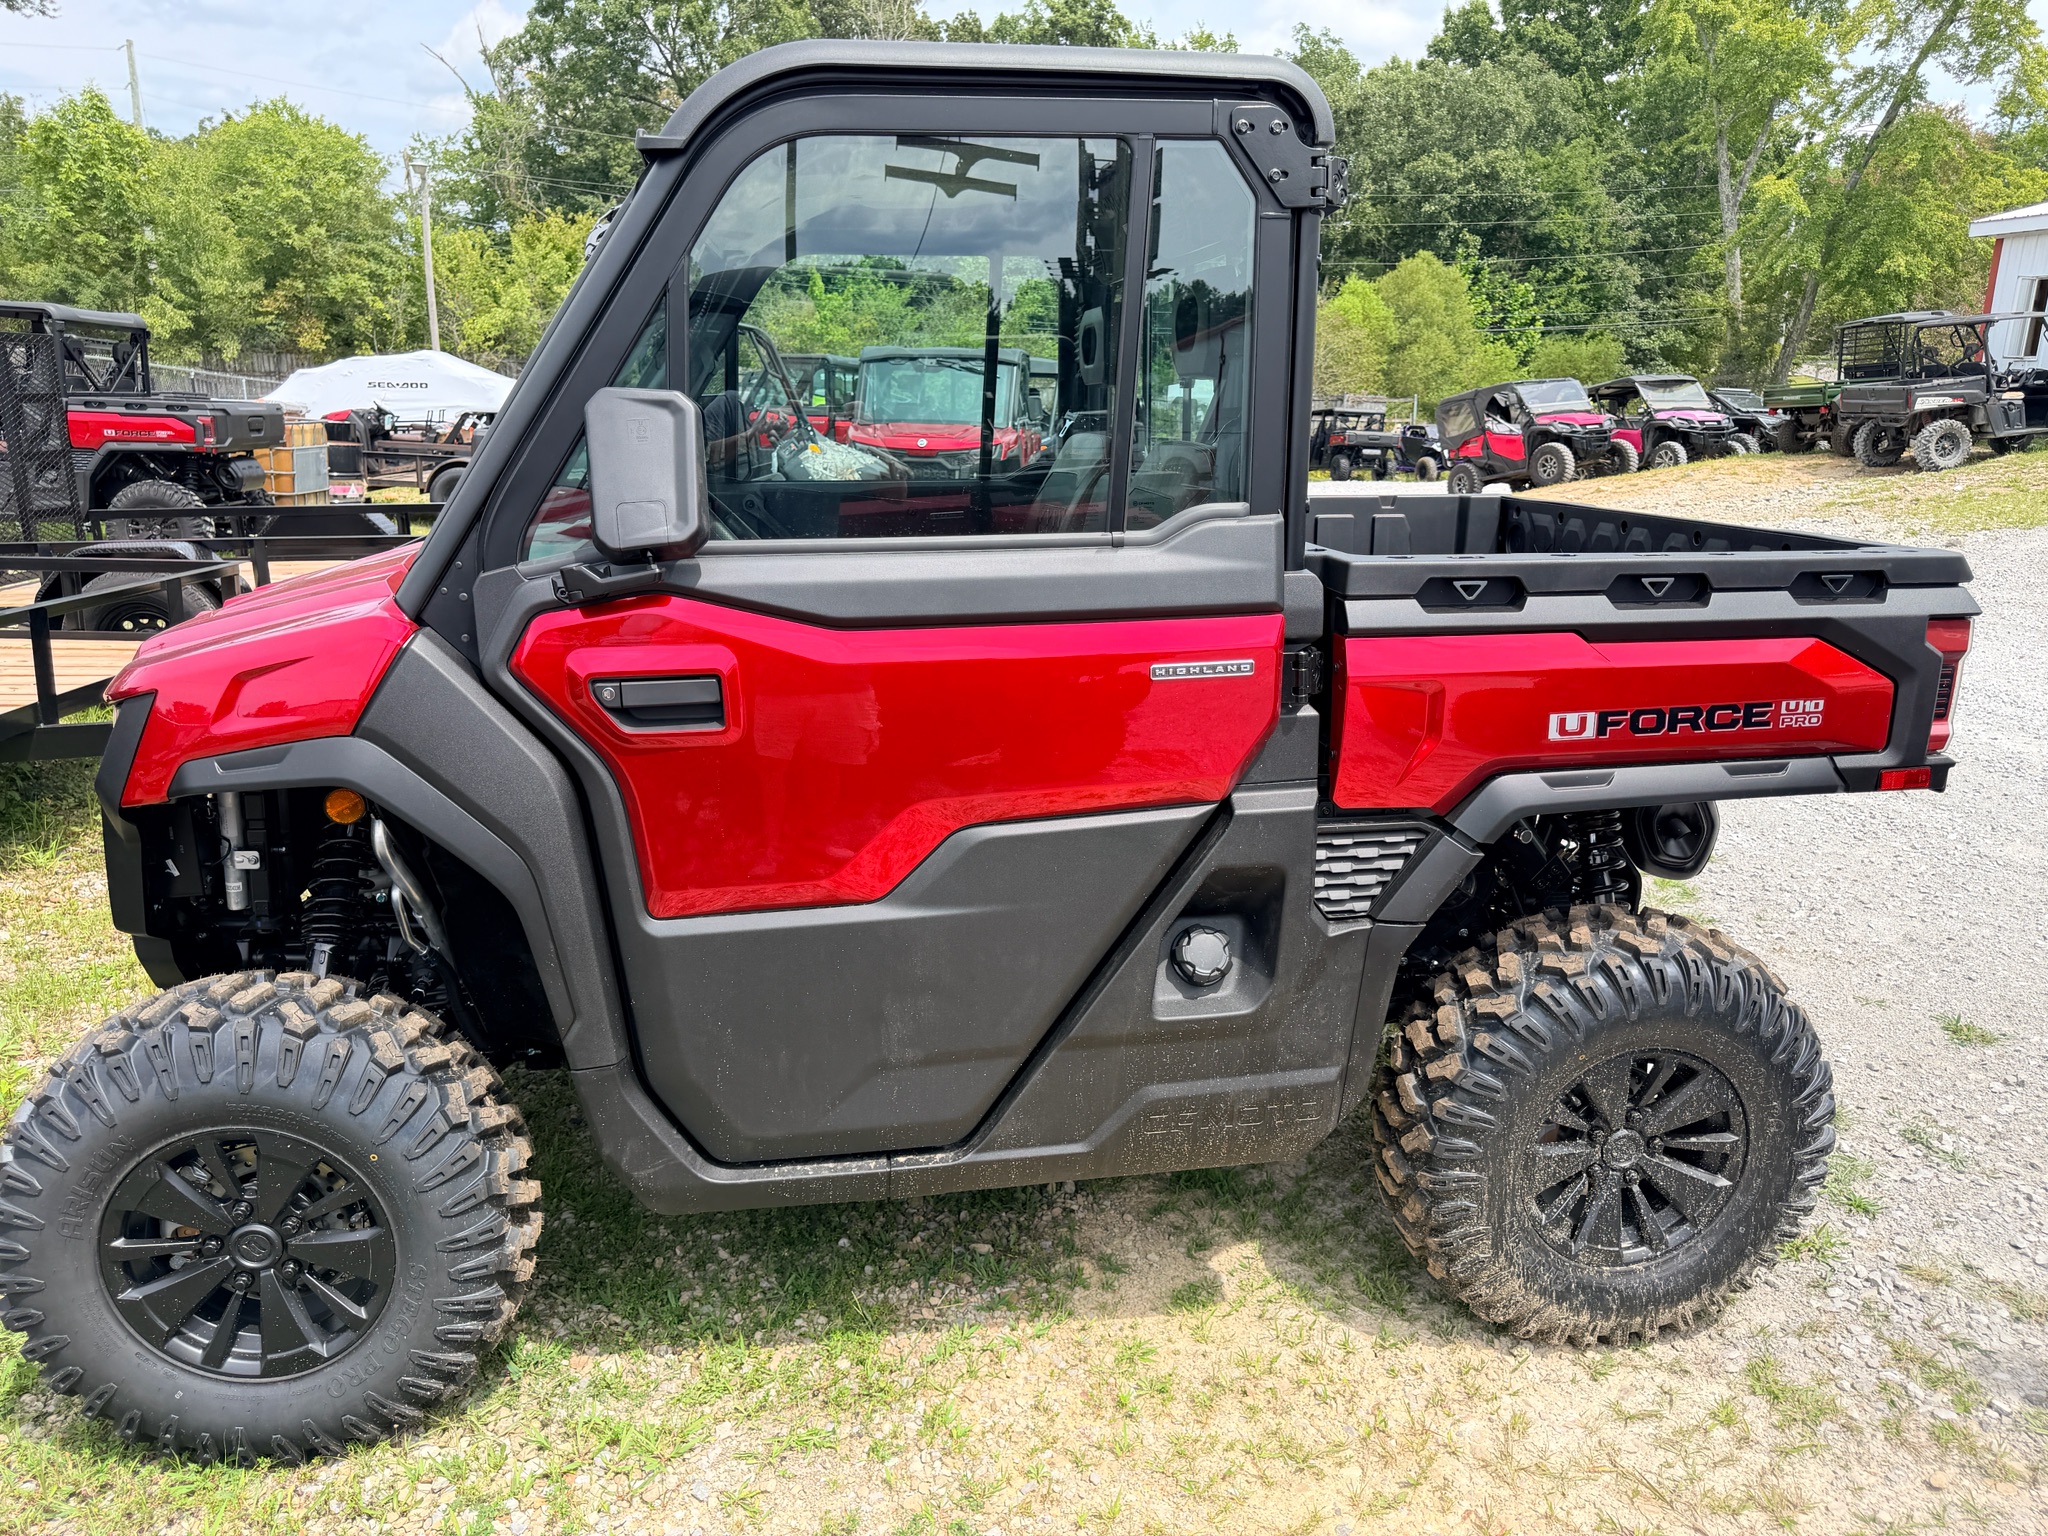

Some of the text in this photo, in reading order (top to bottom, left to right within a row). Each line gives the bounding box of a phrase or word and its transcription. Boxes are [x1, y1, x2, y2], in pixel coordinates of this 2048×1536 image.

[1155, 664, 1251, 676] HIGHLAND
[1780, 699, 1825, 714] U10
[1779, 713, 1823, 729] PRO
[57, 1134, 136, 1240] ARISUN
